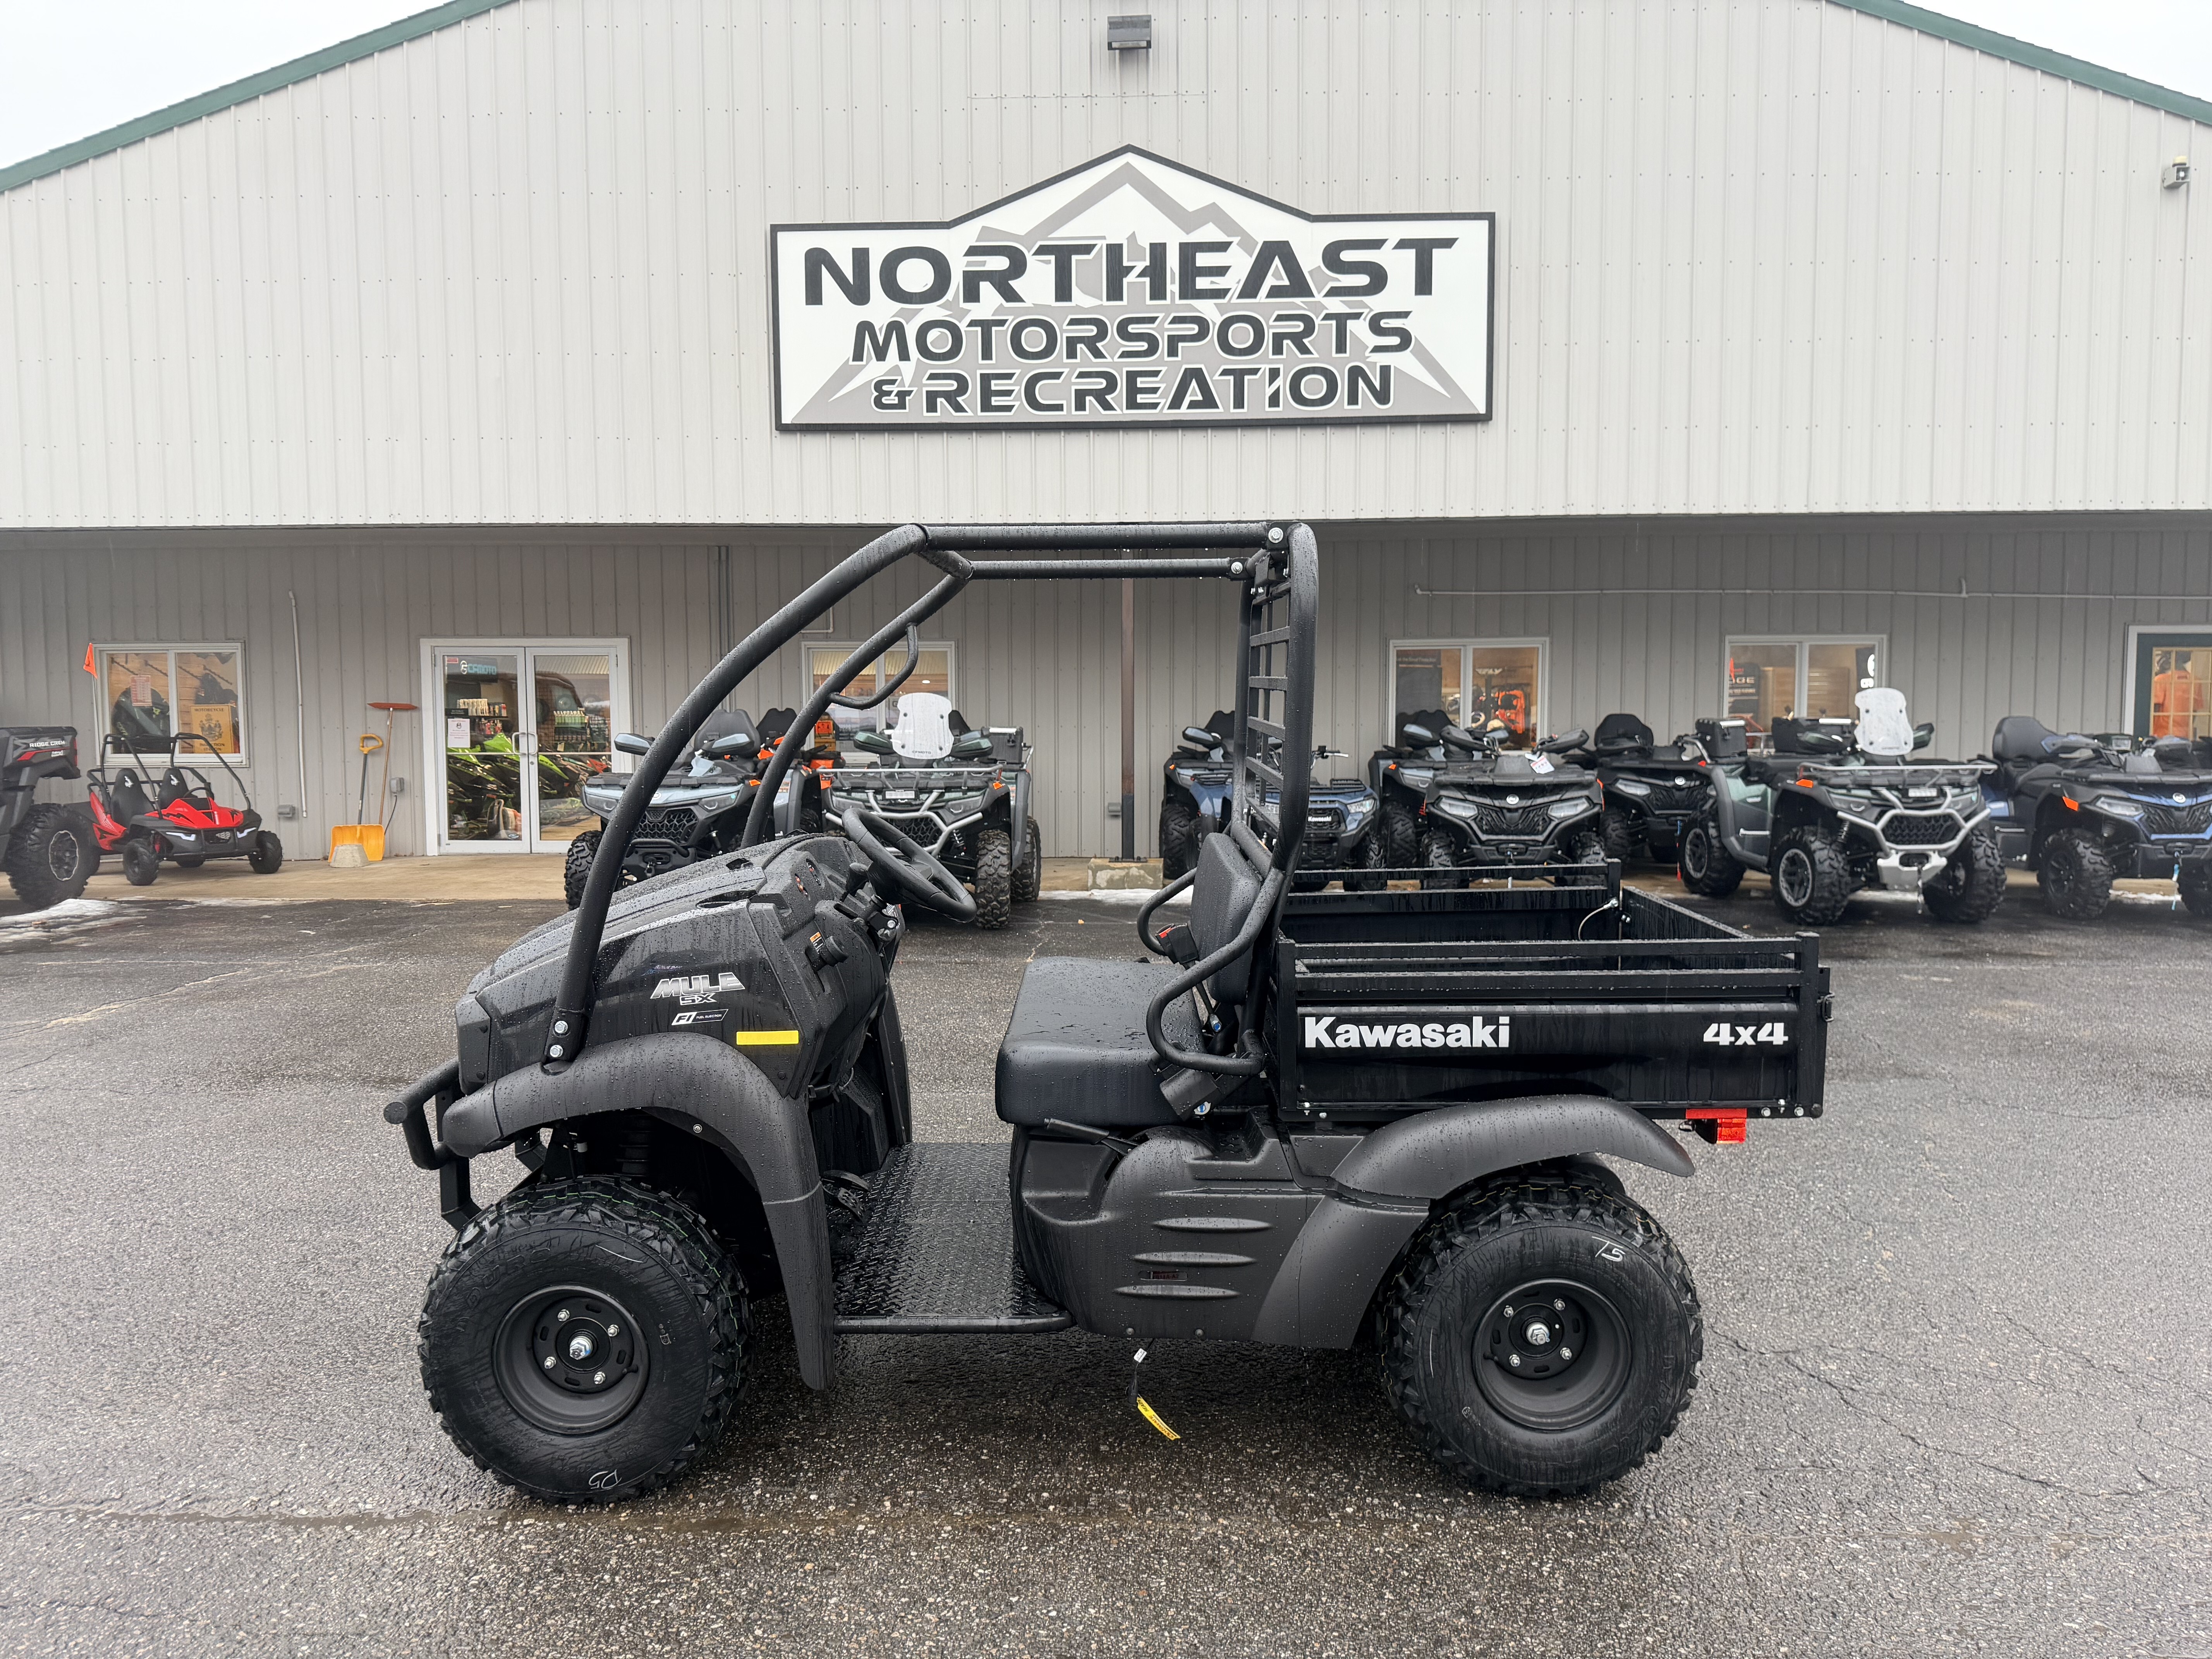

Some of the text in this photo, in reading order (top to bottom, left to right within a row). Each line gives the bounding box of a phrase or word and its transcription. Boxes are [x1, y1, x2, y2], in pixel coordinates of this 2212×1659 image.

[805, 238, 1458, 306] NORTHEAST
[852, 311, 1412, 362] MOTORSPORTS
[926, 365, 1391, 413] RECREATION
[650, 972, 745, 999] MULE
[680, 993, 717, 1006] SX
[1305, 1016, 1510, 1048] Kawasaki
[1703, 1023, 1789, 1045] 4x4
[1137, 1399, 1149, 1412] READY
